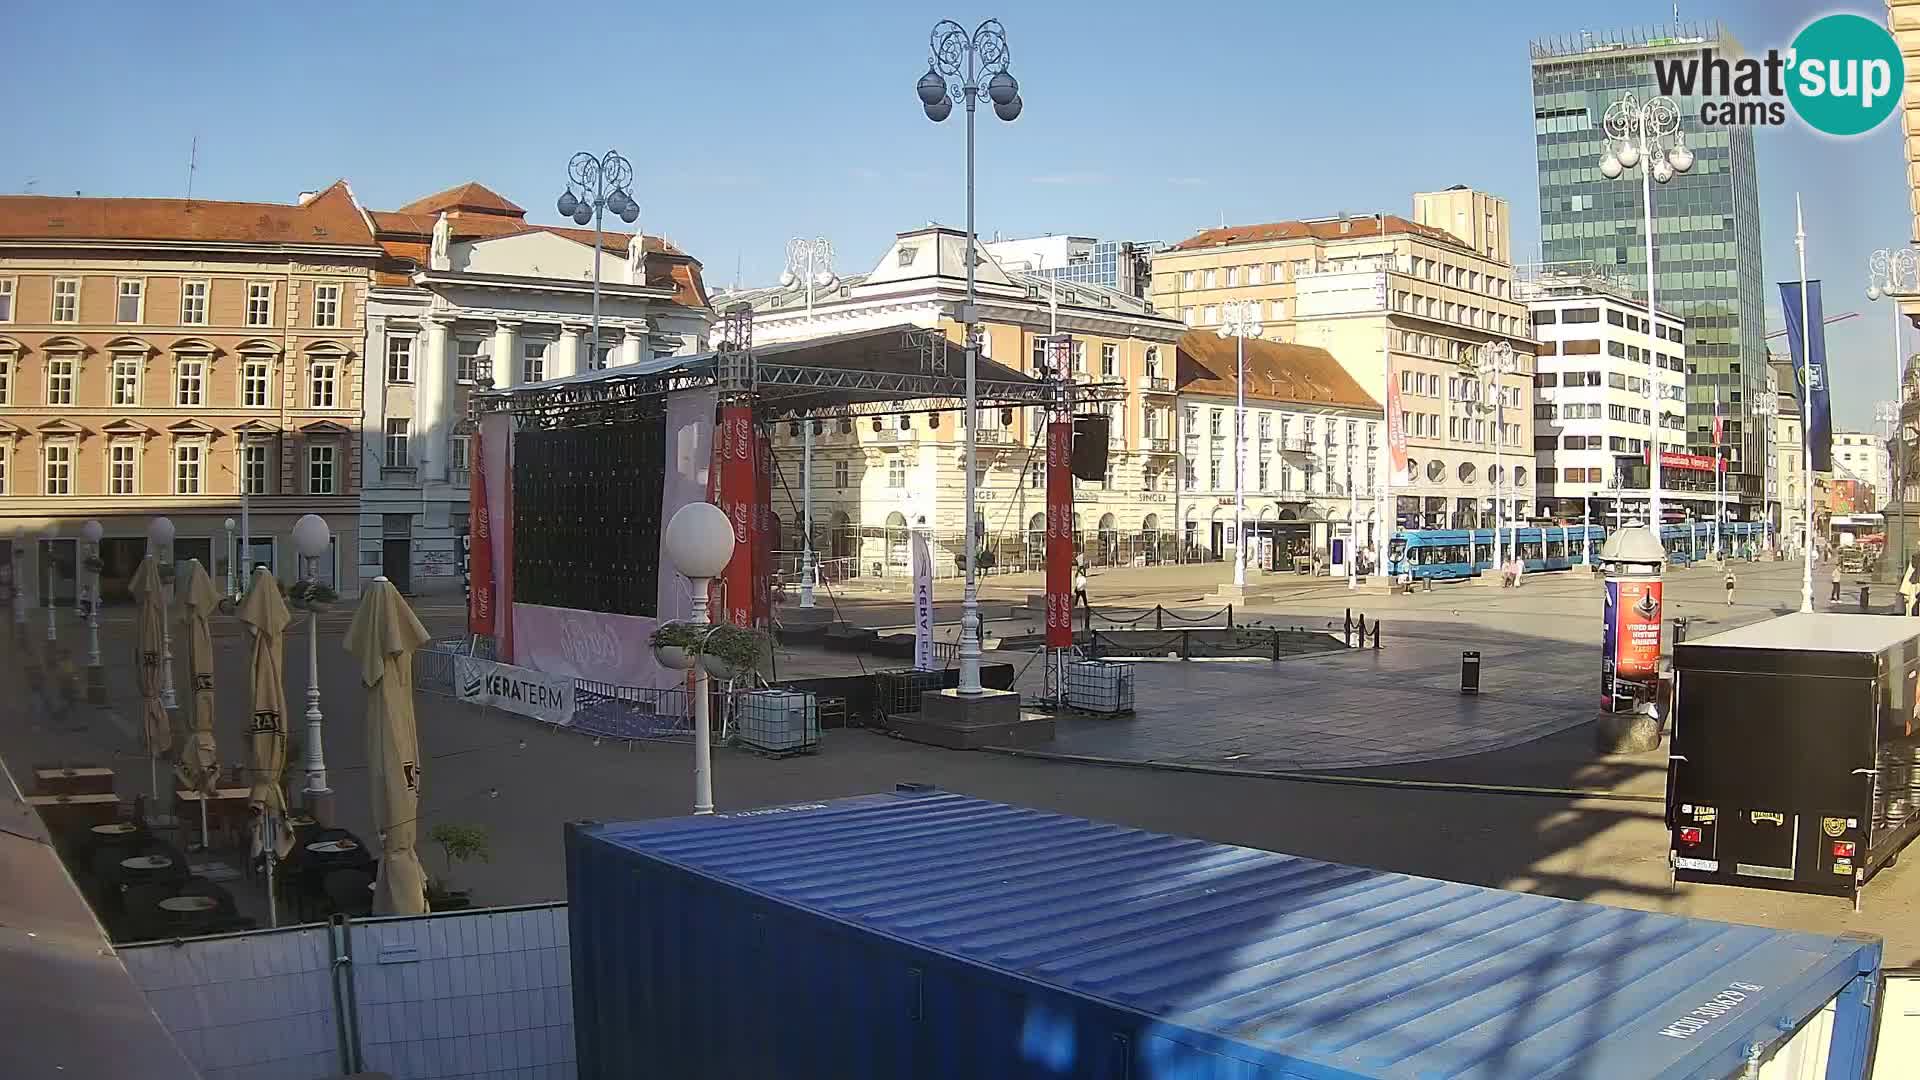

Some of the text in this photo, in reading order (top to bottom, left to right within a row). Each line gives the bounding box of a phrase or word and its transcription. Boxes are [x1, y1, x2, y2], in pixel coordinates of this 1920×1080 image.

[1138, 493, 1167, 502] SINGER
[486, 673, 563, 710] KERATERM
[1691, 989, 1748, 1018] 300629
